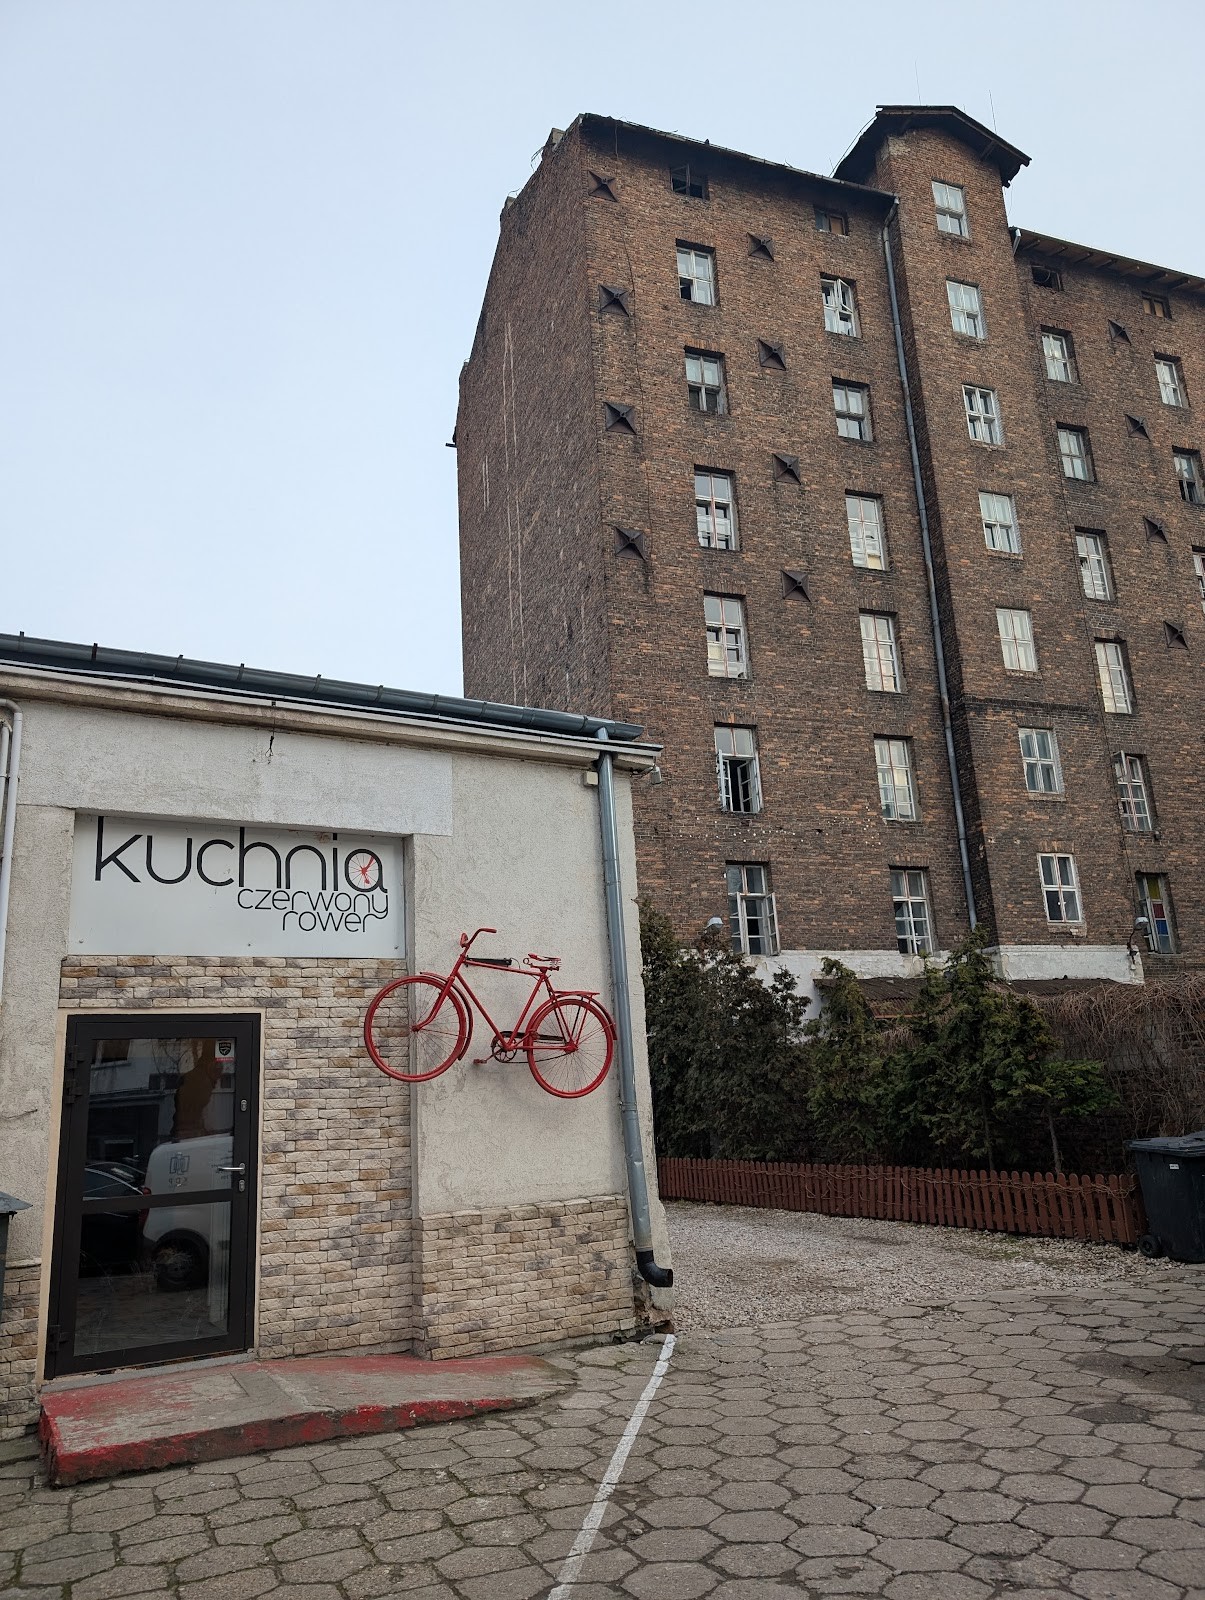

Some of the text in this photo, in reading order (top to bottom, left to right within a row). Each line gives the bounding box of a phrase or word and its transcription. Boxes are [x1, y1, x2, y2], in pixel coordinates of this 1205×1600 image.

[95, 816, 388, 893] kuchnia
[237, 888, 388, 919] czerwony
[282, 910, 377, 933] rower
